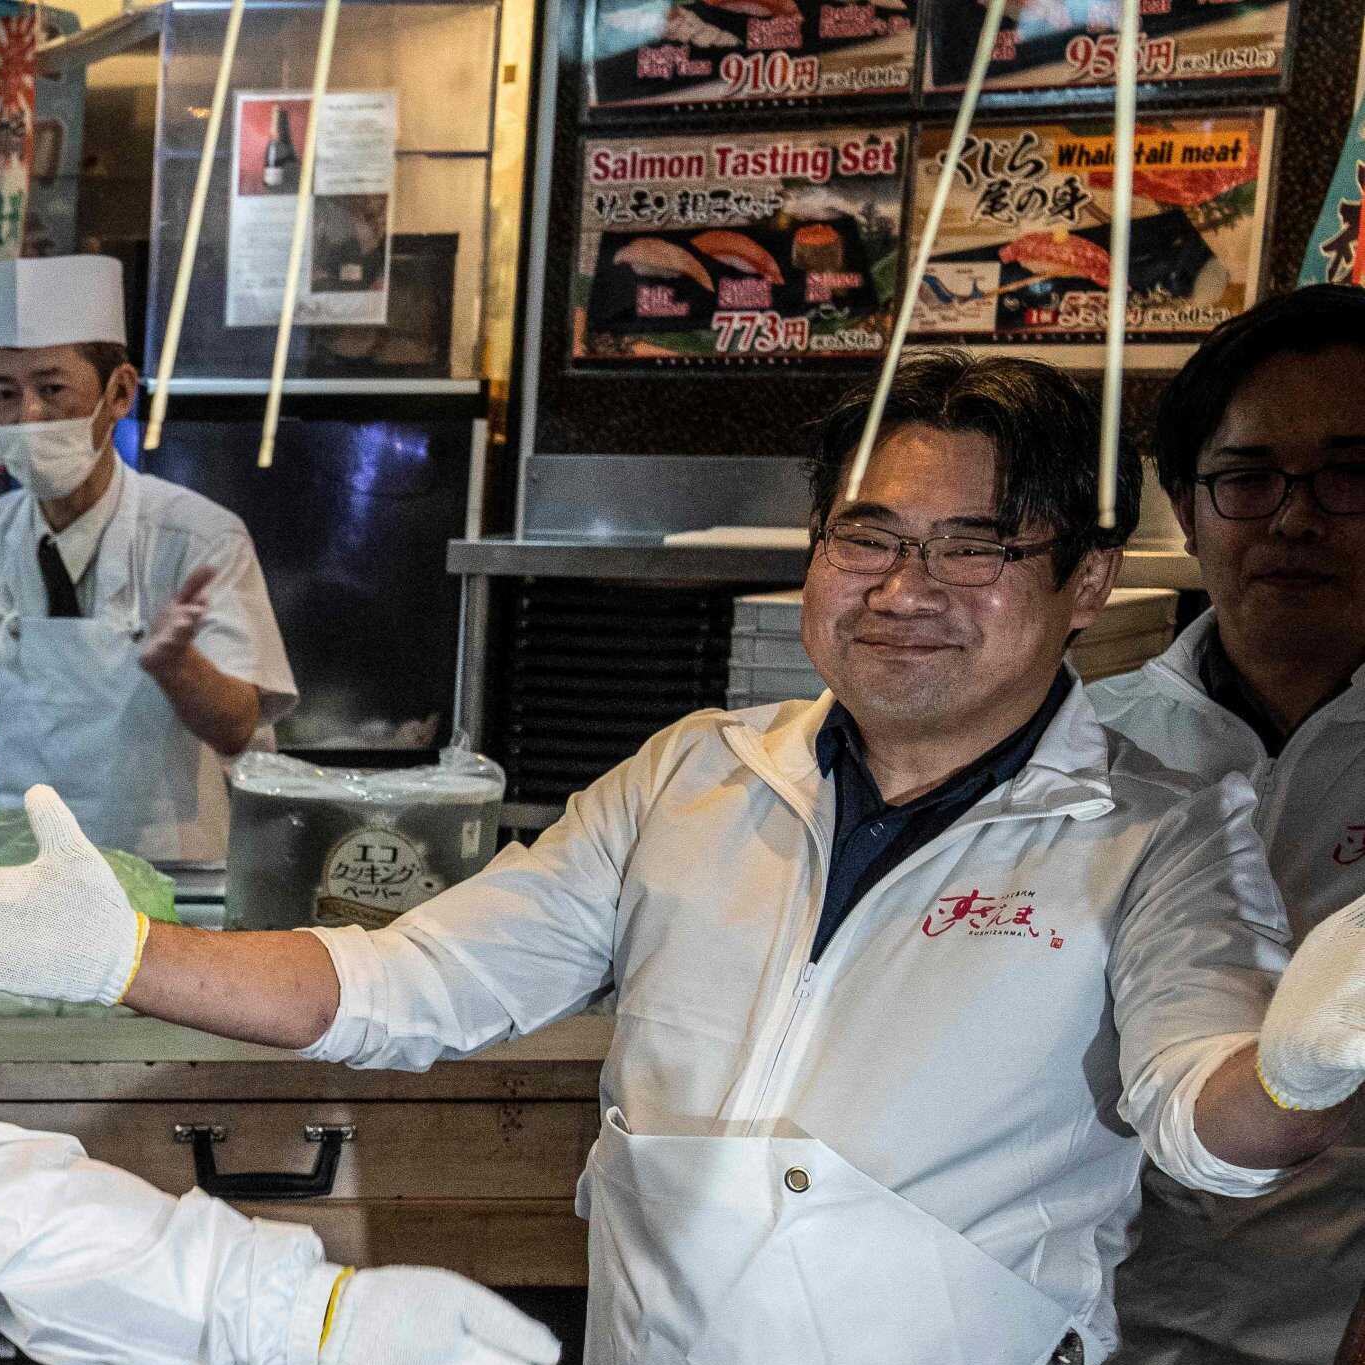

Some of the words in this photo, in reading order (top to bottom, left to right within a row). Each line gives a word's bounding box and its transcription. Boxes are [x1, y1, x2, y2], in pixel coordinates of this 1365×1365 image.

[720, 51, 820, 95] 910円
[592, 149, 704, 181] Salmon
[716, 143, 831, 182] Tasting
[840, 139, 896, 174] Set
[944, 130, 1047, 186] くじら
[1181, 138, 1242, 165] meat
[712, 311, 810, 352] 773円
[334, 862, 420, 885] クッキング
[354, 844, 398, 863] エコ
